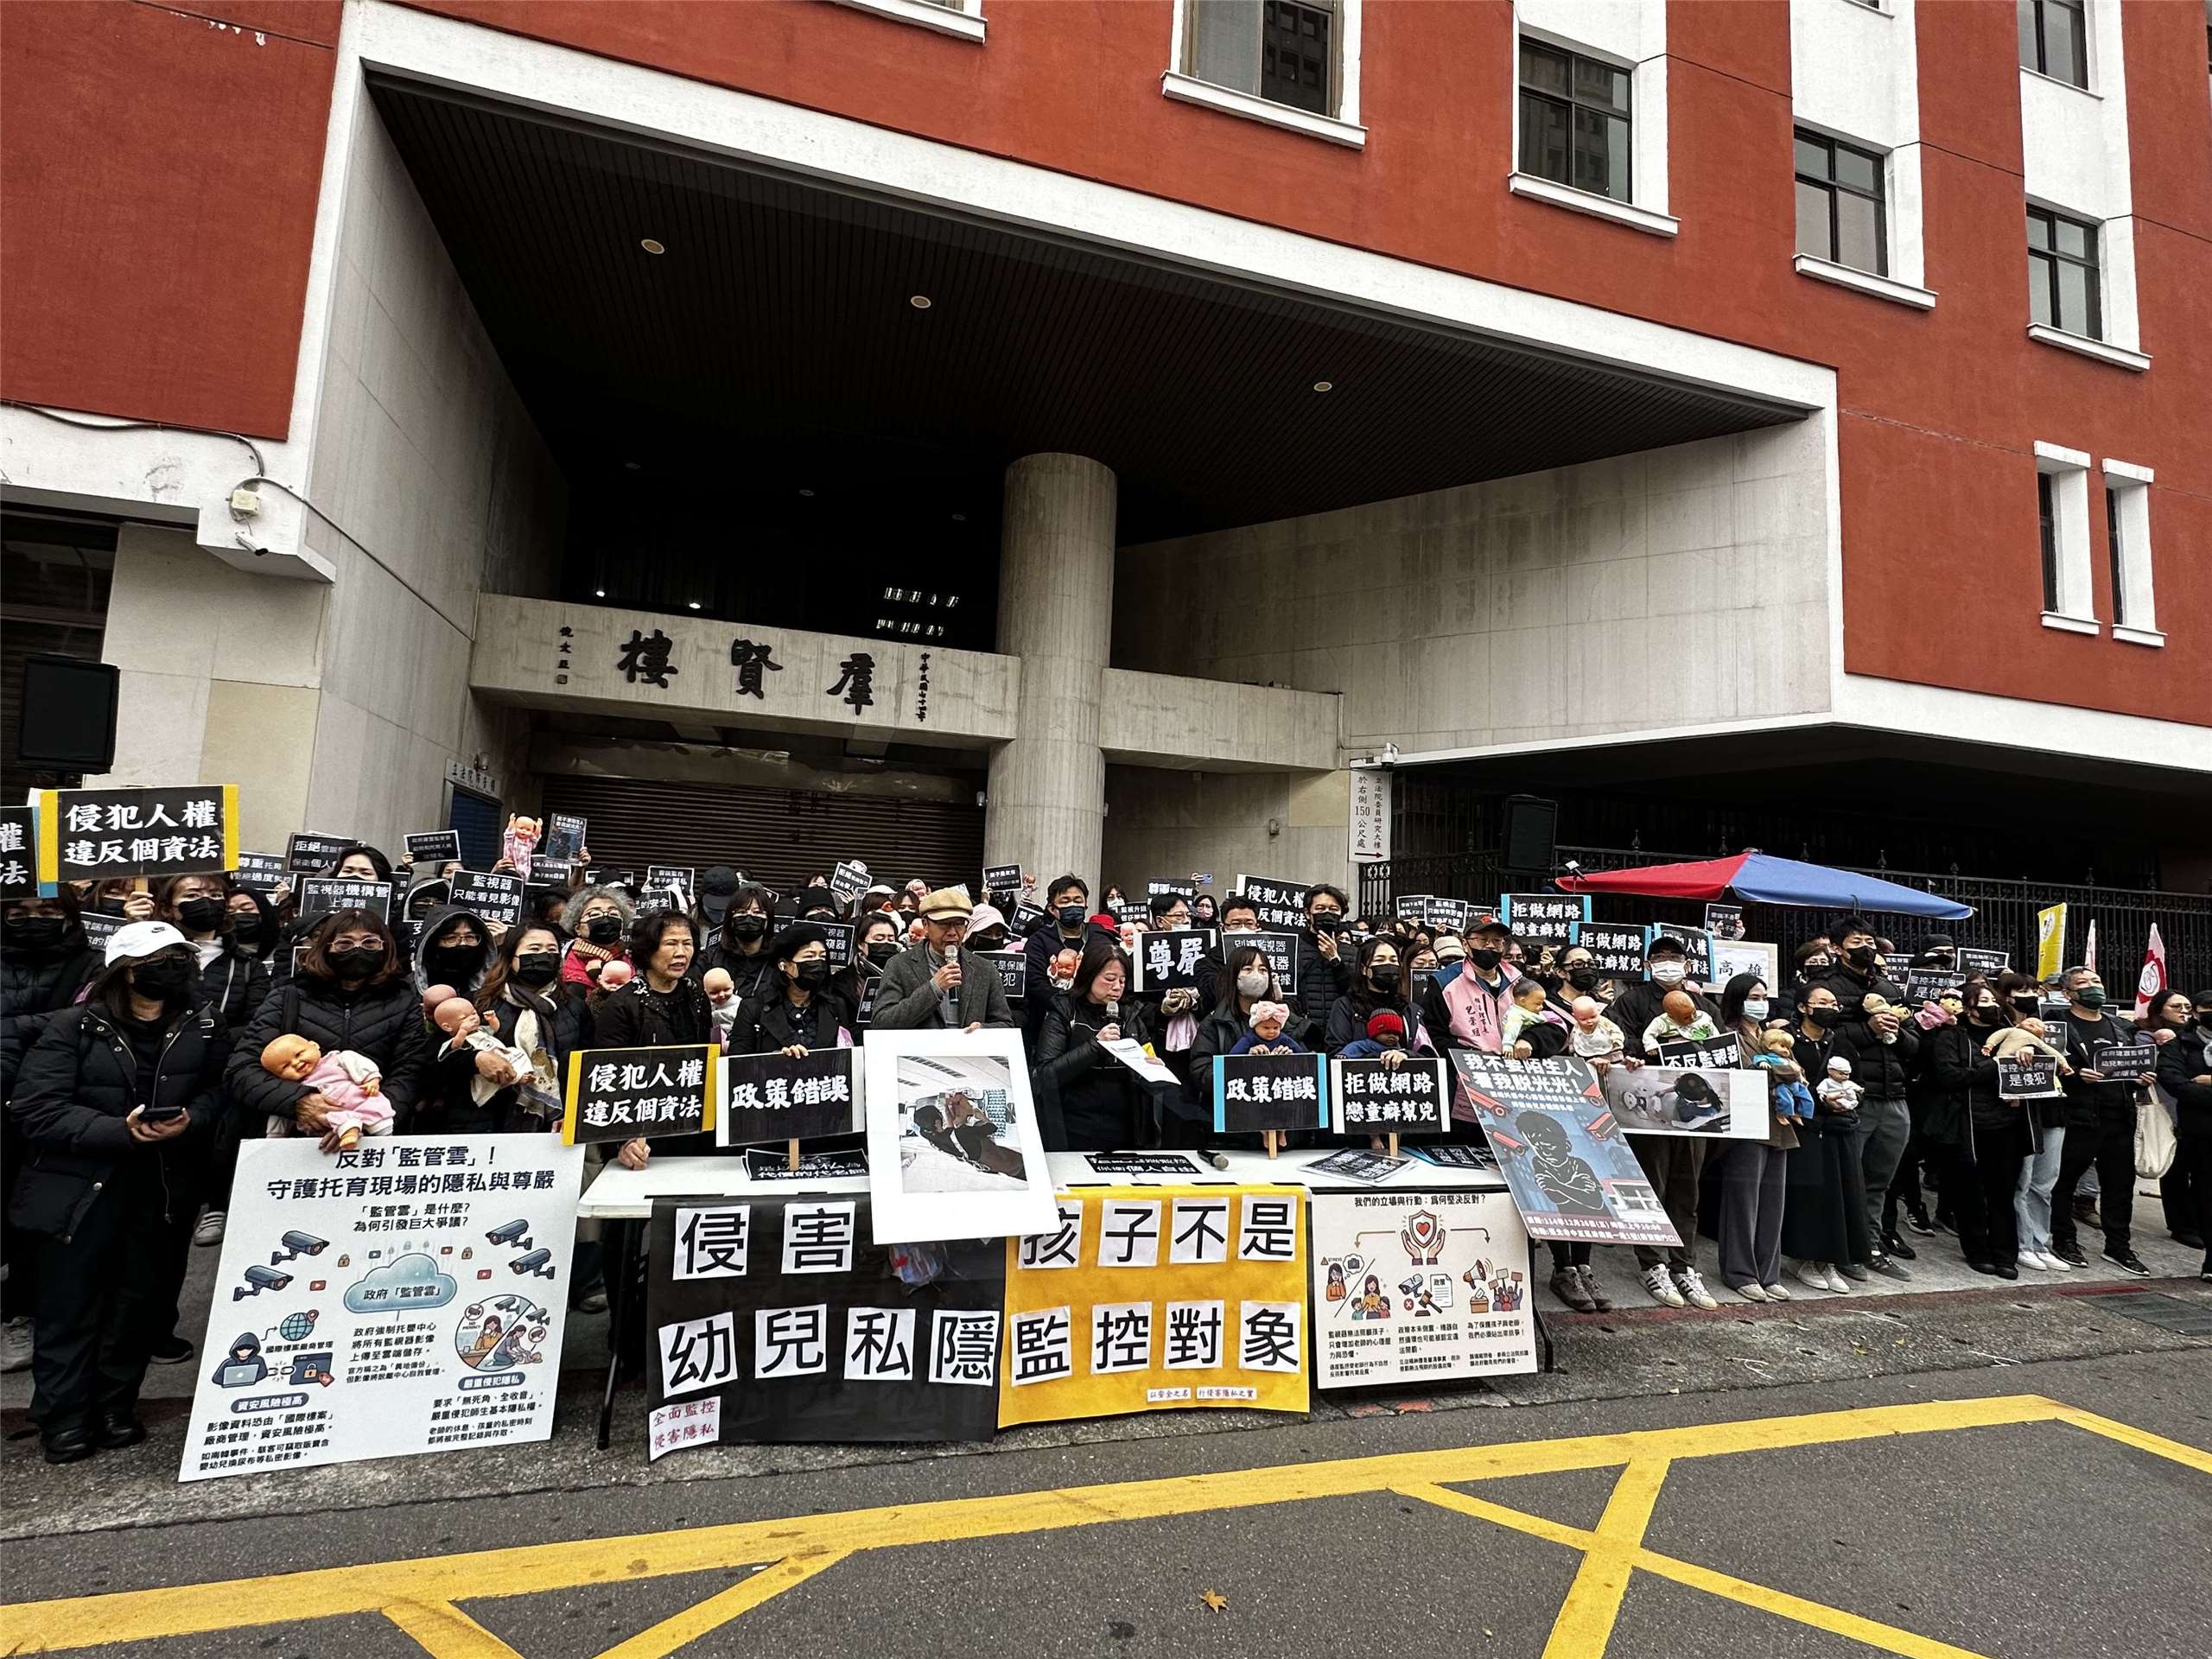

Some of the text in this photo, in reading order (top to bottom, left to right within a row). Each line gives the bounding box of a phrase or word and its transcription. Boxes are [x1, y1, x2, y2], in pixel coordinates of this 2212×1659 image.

[65, 799, 219, 832] 侵犯人權
[1355, 776, 1370, 849] 於右側150公尺處
[64, 835, 219, 867] 違反個資法
[472, 874, 512, 890] 監視器
[453, 888, 520, 906] 只能看見影像
[1247, 884, 1306, 908] 侵犯人權
[1257, 909, 1306, 927] 反個資法
[1511, 903, 1582, 920] 拒做網路
[823, 927, 844, 938] 視器
[1511, 922, 1571, 938] 戀童癖幫
[1580, 931, 1643, 950] 拒做網路
[1146, 937, 1206, 981] 尊嚴
[1719, 959, 1764, 977] 高雄
[1463, 1053, 1584, 1077] 我不要陌生人
[1665, 1045, 1739, 1069] 不反監視器
[588, 1058, 703, 1093] 侵犯人權
[1344, 1071, 1434, 1096] 拒做網路
[2008, 1071, 2046, 1087] 是侵犯
[731, 1074, 850, 1110] 政策錯誤
[1226, 1076, 1317, 1103] 政策錯誤
[583, 1094, 702, 1127] 違反個資法
[1344, 1100, 1438, 1122] 戀童癖幫兇
[267, 1169, 555, 1200] 守護托育現場的隱私與尊嚴
[681, 1208, 851, 1274] 侵害
[352, 1334, 435, 1349] 將所有監視器影像
[353, 1322, 436, 1337] 政府強制托嬰中心
[668, 1309, 995, 1389] 幼兒私隱
[1015, 1307, 1298, 1381] 監控對象
[237, 1395, 303, 1411] 資安風險極高
[653, 1401, 715, 1427] 全面監控
[654, 1423, 714, 1450] 侵害隱私
